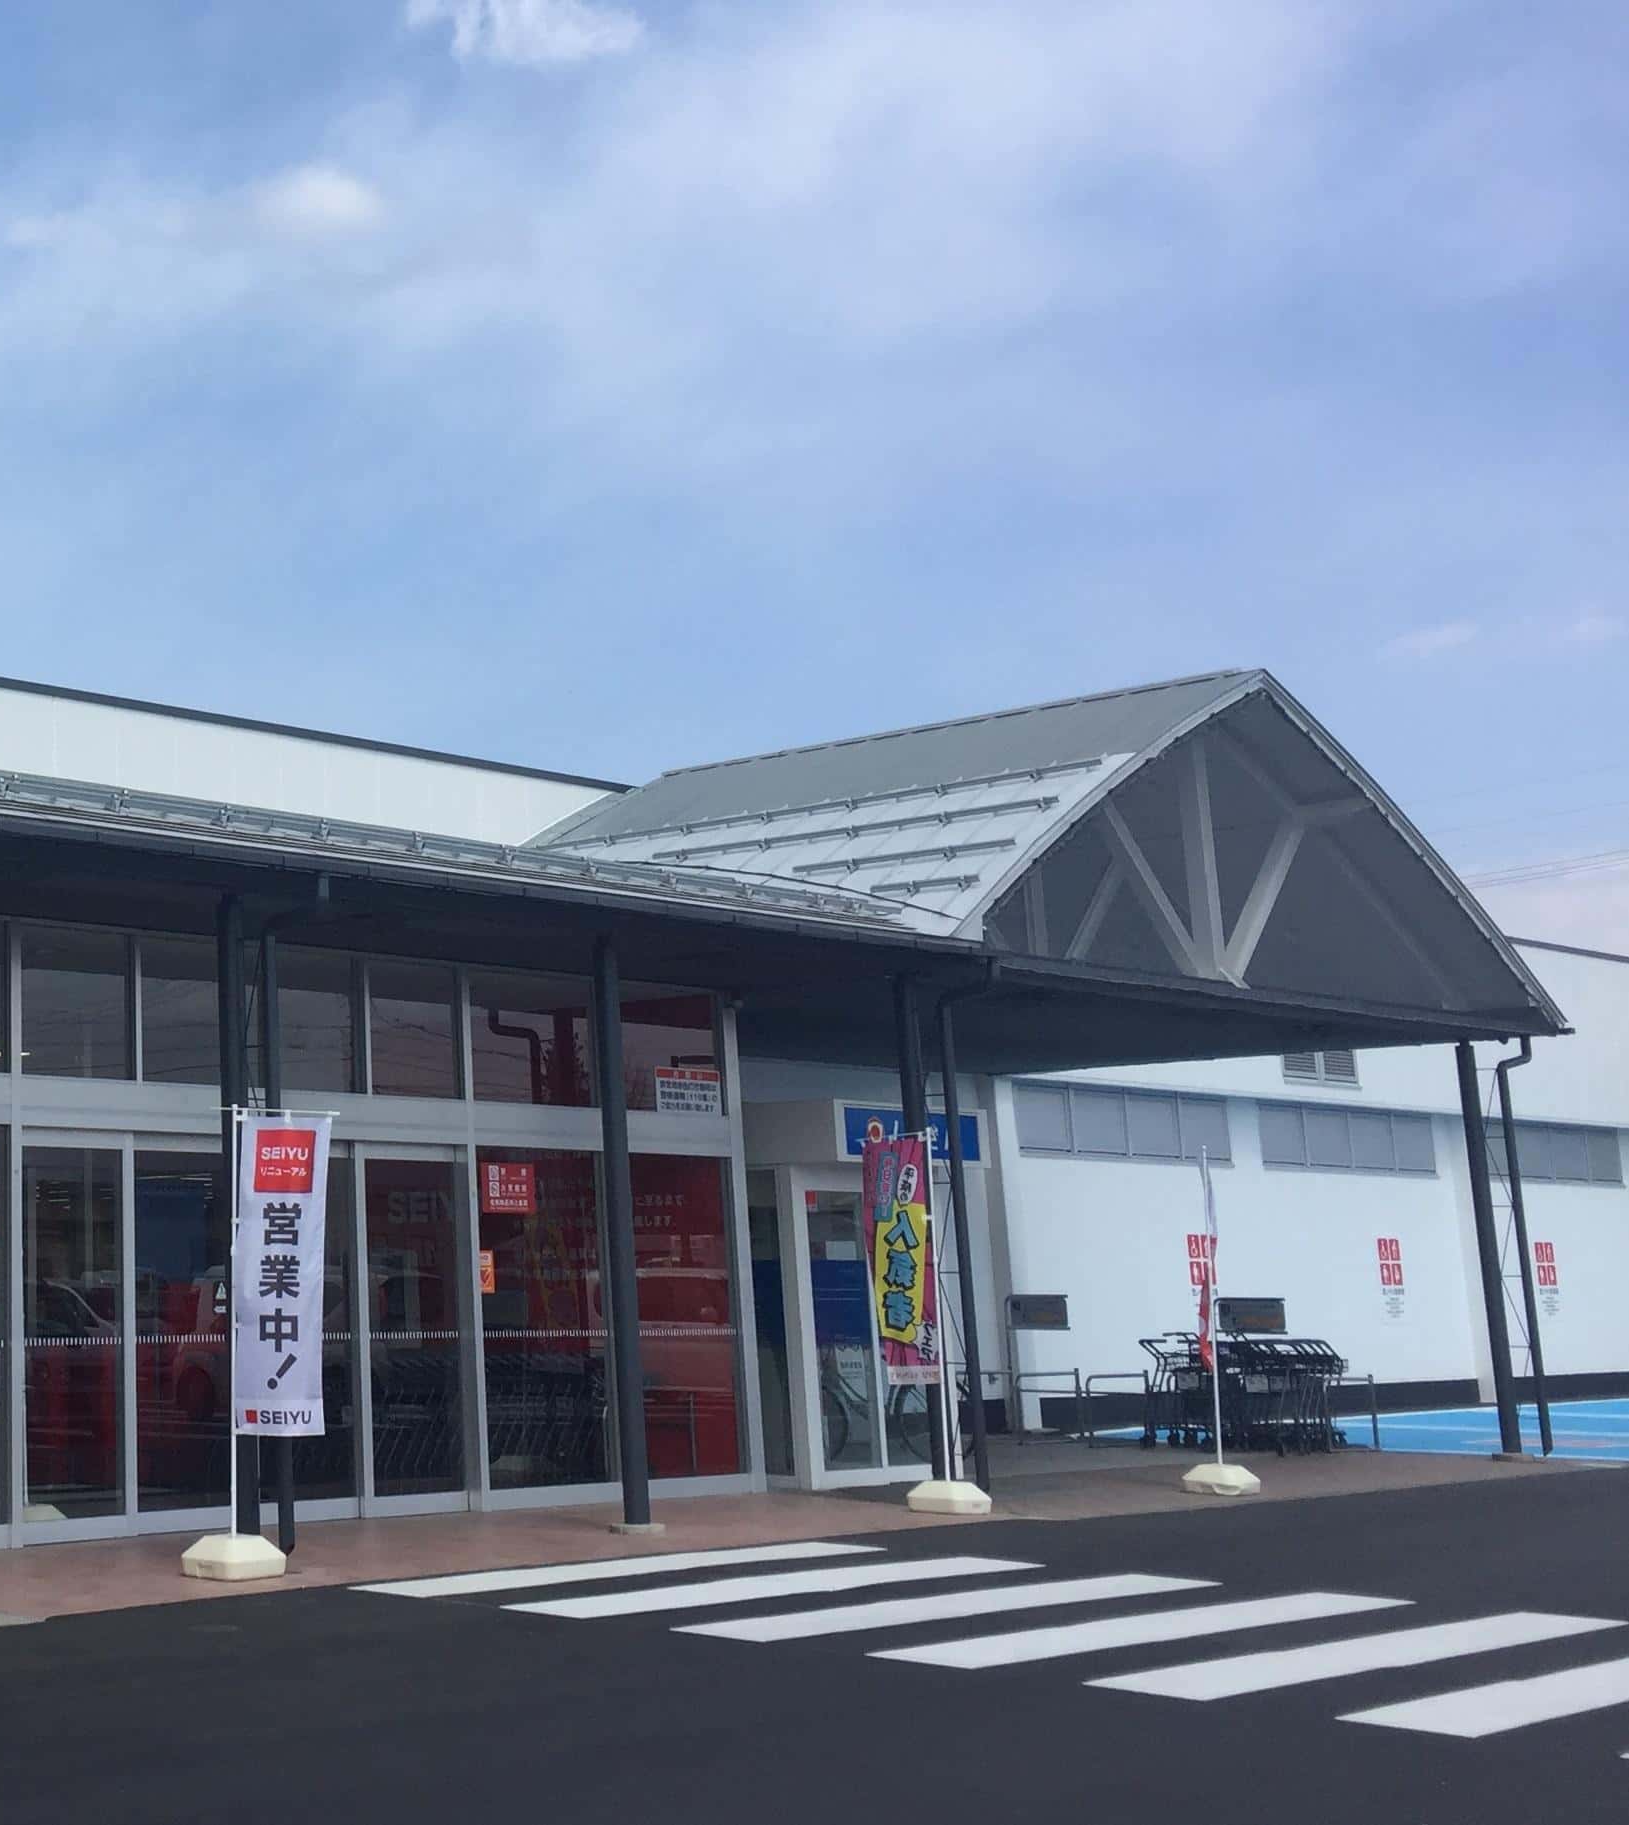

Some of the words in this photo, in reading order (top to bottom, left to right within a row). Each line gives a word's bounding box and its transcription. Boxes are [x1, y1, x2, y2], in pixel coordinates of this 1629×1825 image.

[260, 1146, 309, 1161] SEIYU
[260, 1166, 308, 1177] リニューアル
[259, 1409, 312, 1425] SEIYU
